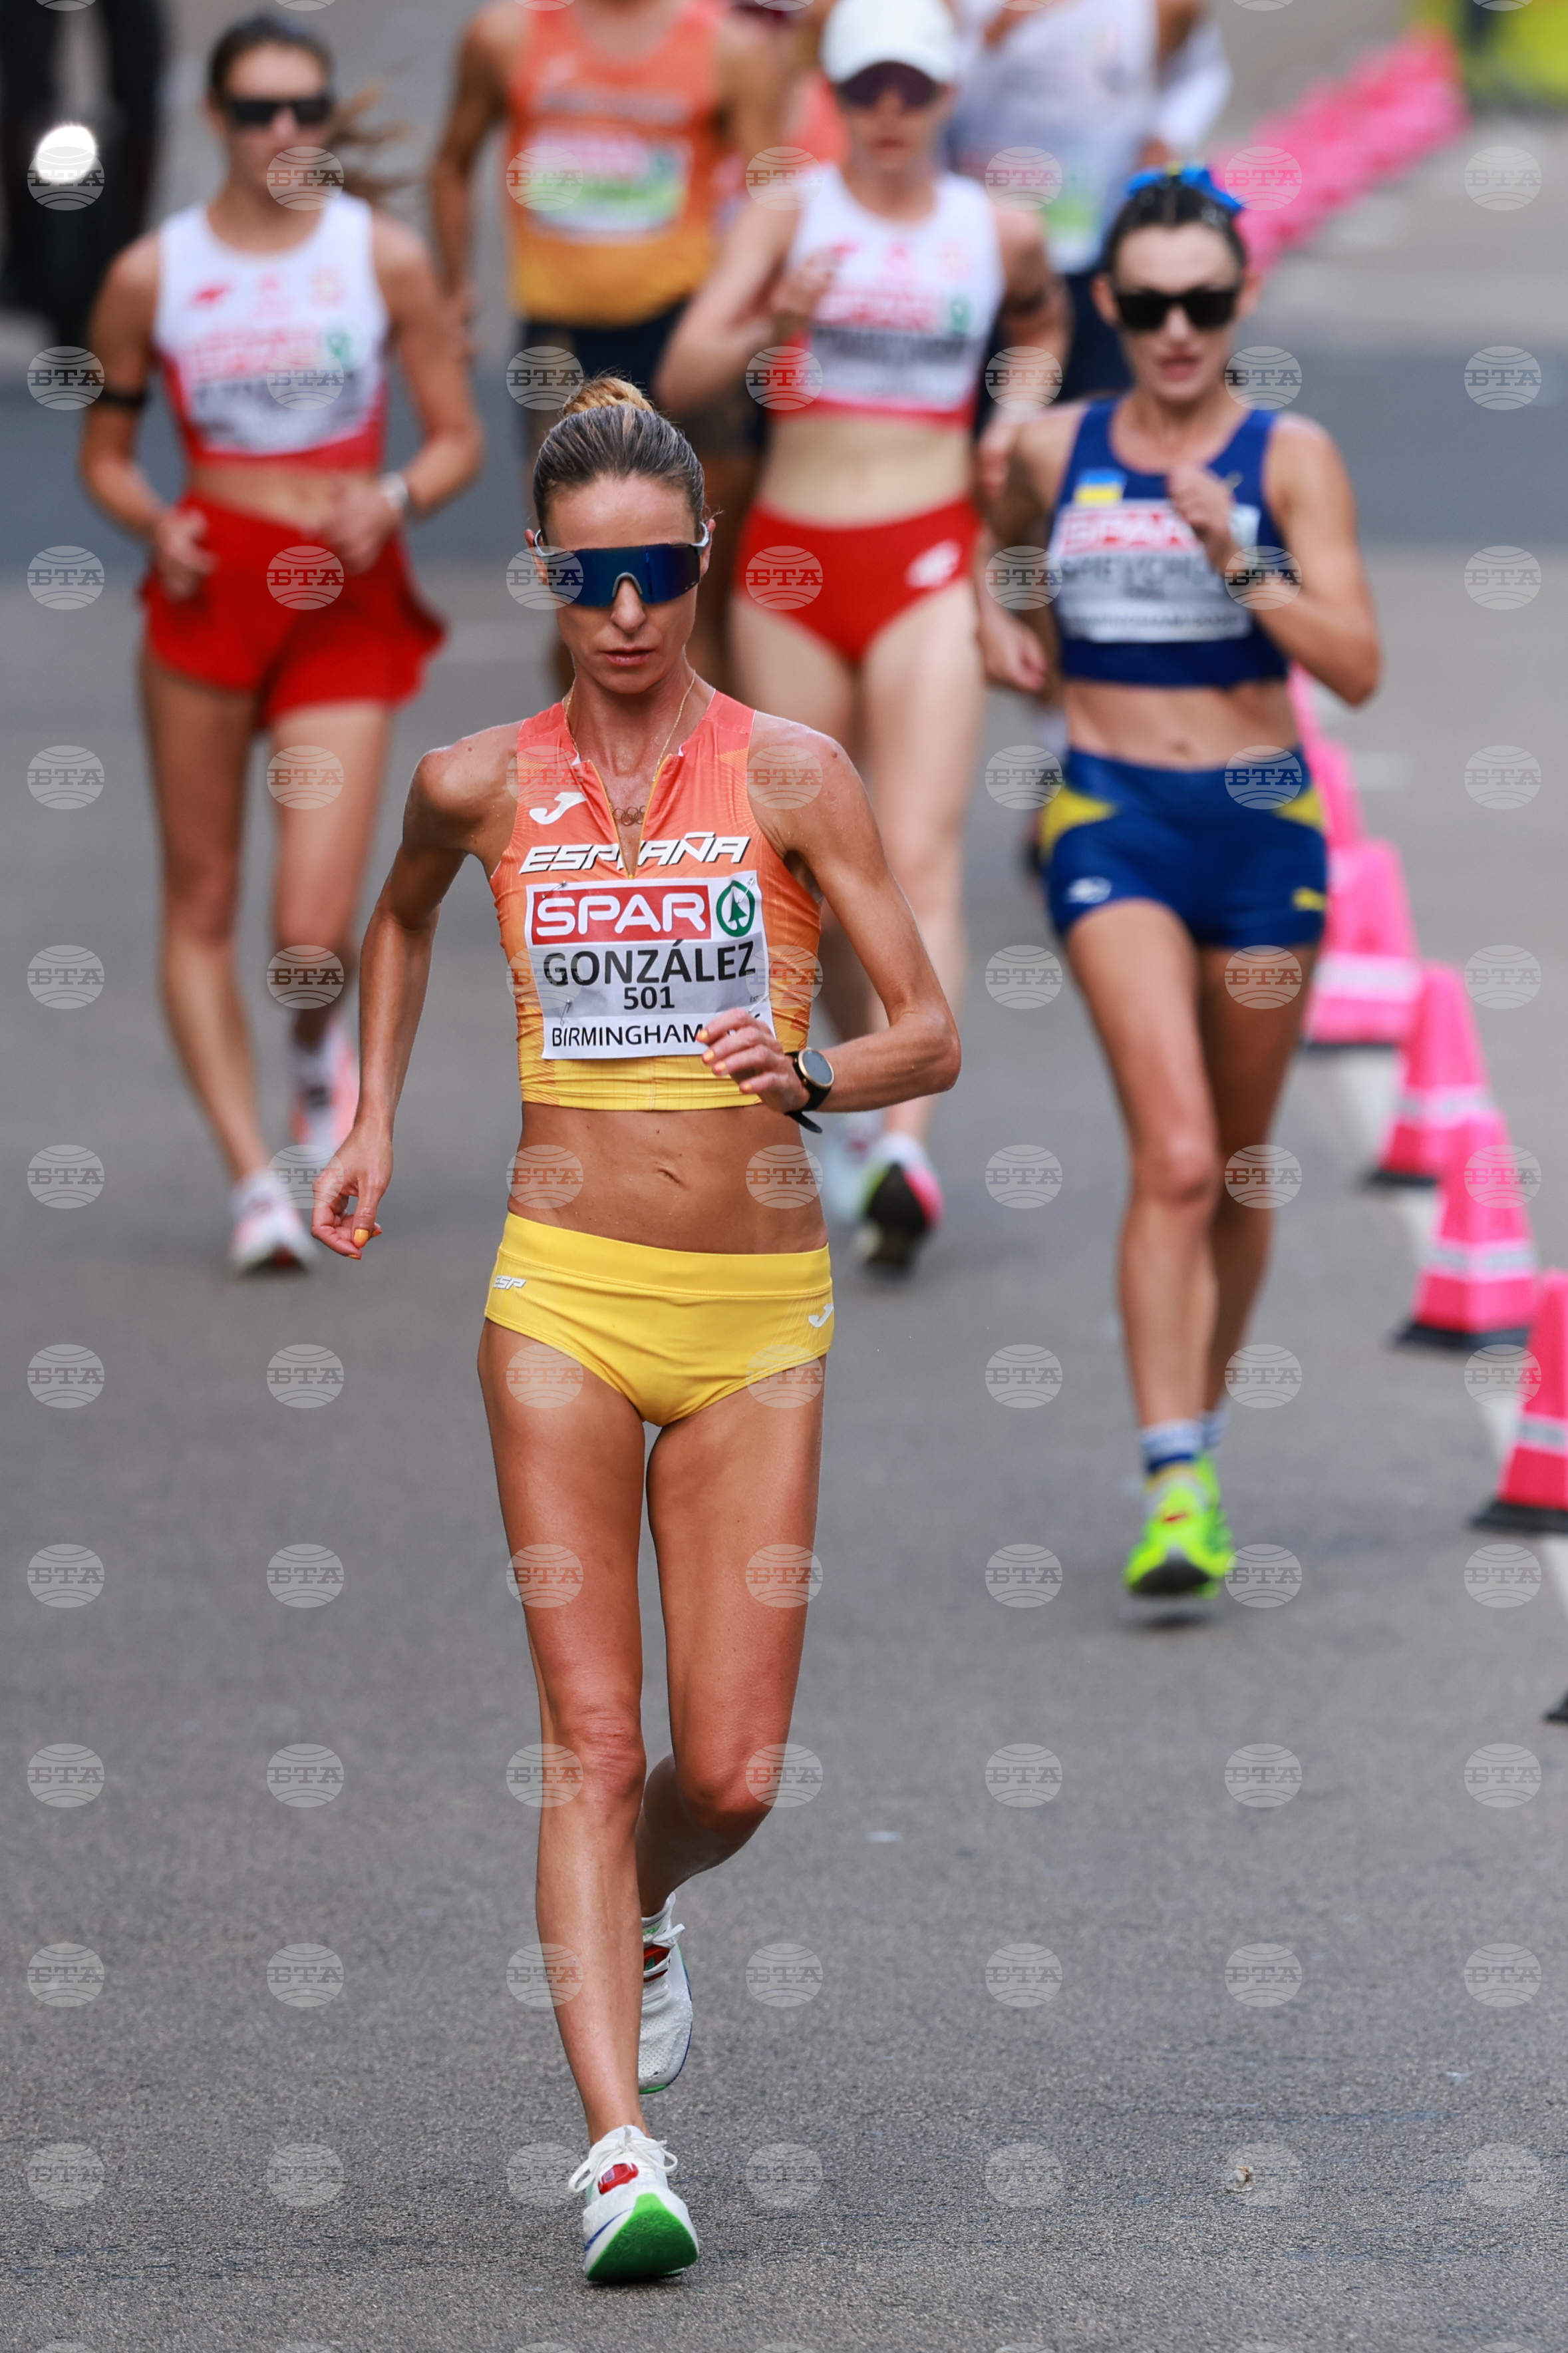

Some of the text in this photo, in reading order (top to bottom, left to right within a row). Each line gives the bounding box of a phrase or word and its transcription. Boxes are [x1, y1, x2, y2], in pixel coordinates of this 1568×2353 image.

[520, 832, 750, 874] ESPAÑA
[536, 893, 706, 936] SPAR
[543, 939, 756, 986] GONZÁLEZ
[623, 986, 675, 1010] 501
[551, 1023, 703, 1047] BIRMINGHAM
[493, 1275, 527, 1290] ESP
